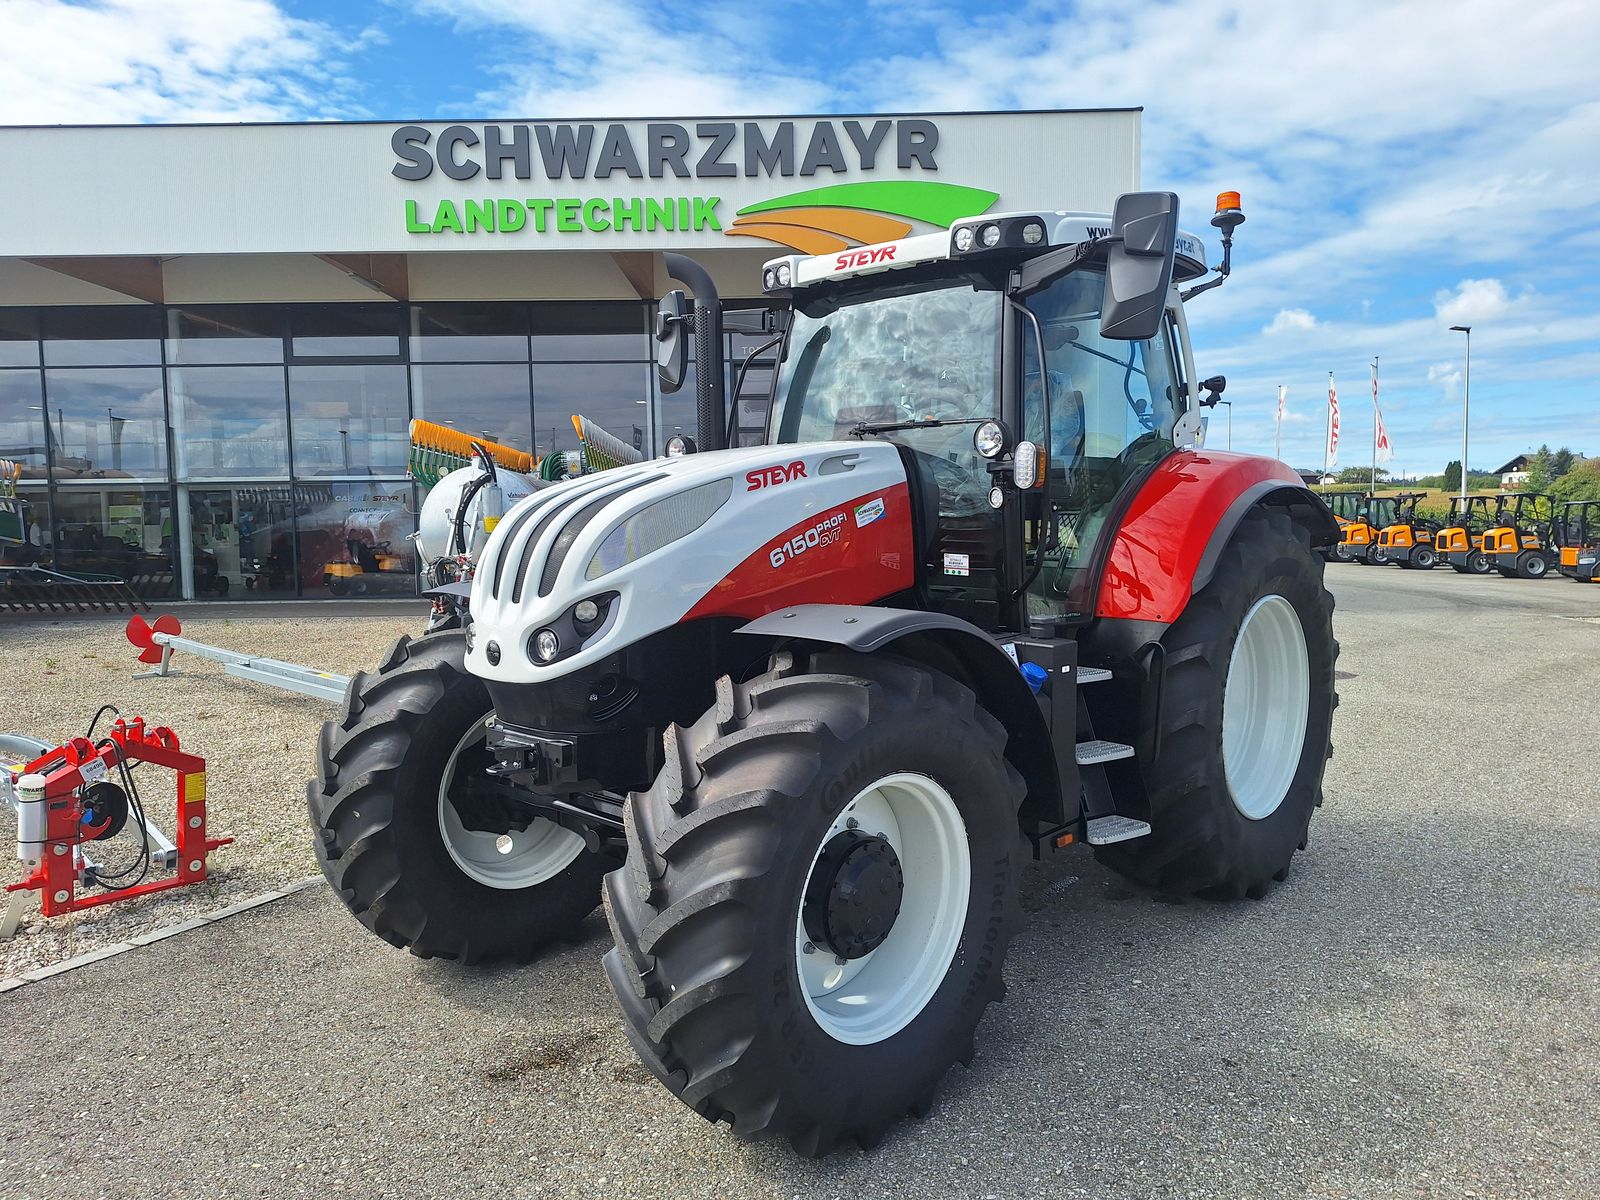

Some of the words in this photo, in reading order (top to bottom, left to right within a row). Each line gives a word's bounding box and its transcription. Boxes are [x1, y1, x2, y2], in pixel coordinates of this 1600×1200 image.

[391, 120, 940, 180] SCHWARZMAYR
[405, 195, 722, 234] LANDTECHNIK
[834, 245, 897, 271] STEYR
[746, 460, 808, 491] STEYR
[769, 527, 820, 568] 6150
[817, 512, 848, 534] PROFI
[819, 526, 841, 548] CVT
